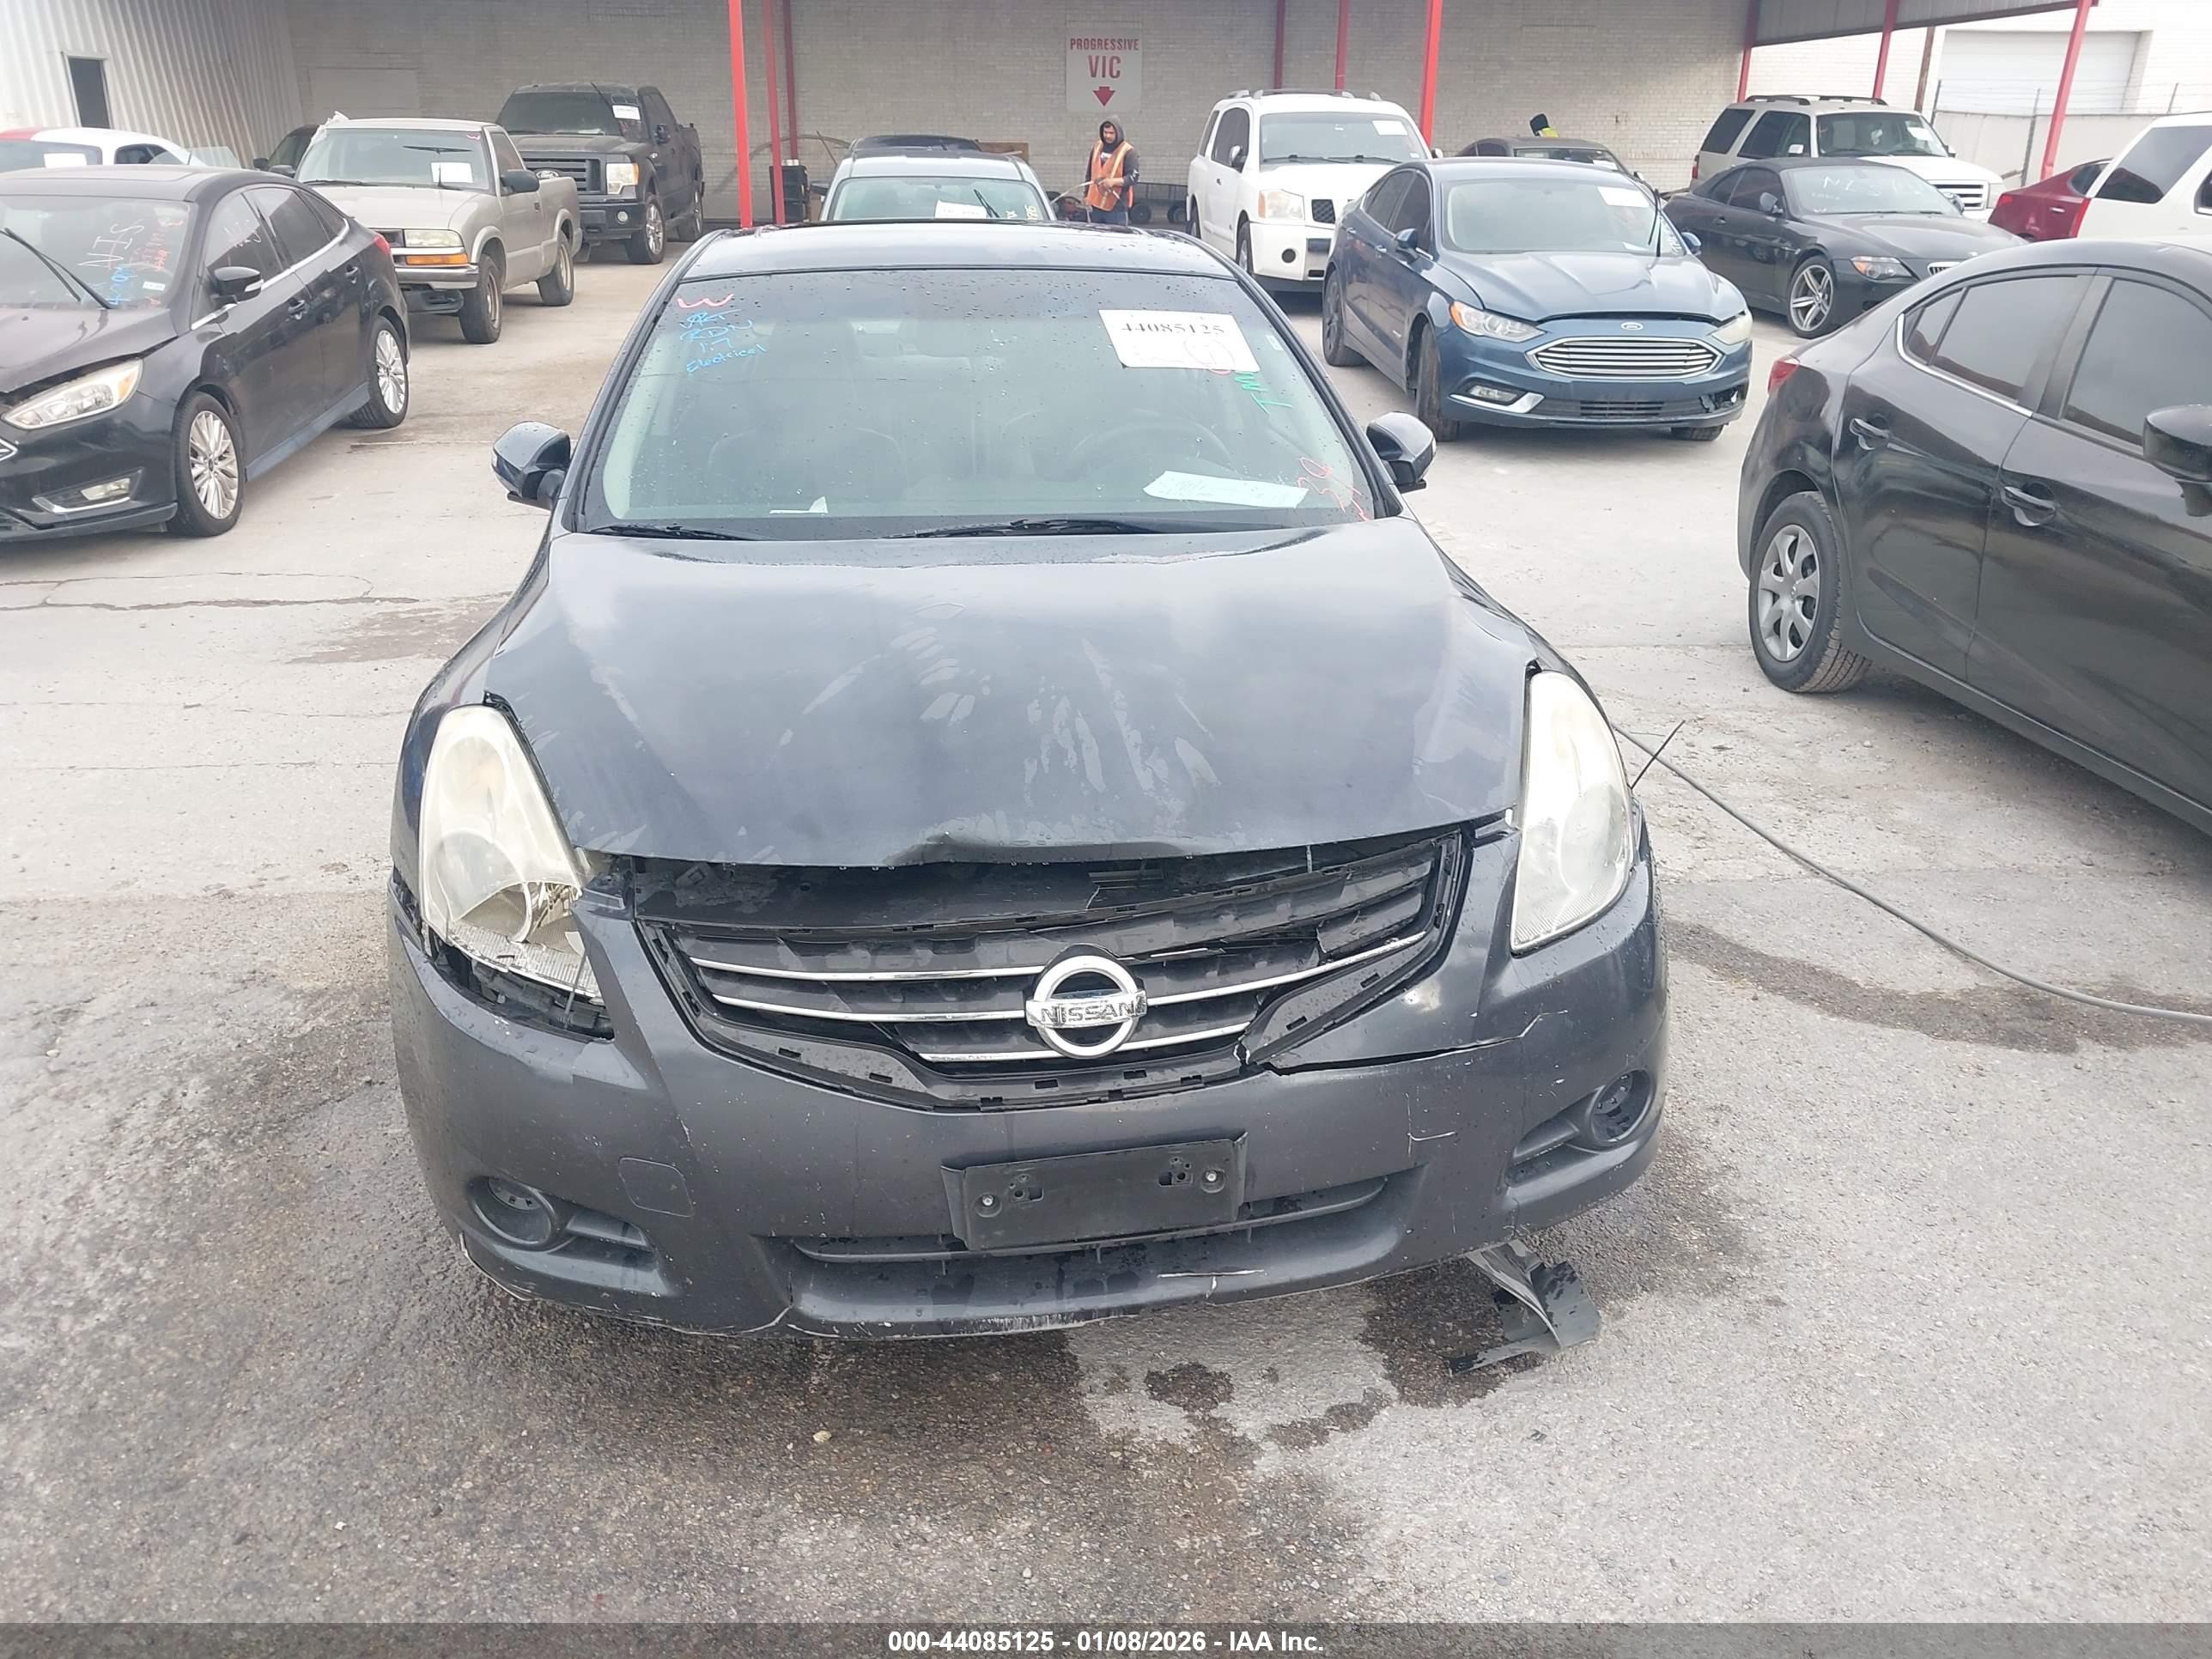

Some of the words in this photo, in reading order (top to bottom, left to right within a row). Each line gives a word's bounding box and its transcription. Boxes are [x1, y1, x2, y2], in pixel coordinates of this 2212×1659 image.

[1069, 37, 1140, 51] PROGRESSIVE
[1088, 54, 1121, 79] VIC
[1121, 322, 1226, 335] 44085125
[1040, 1000, 1135, 1026] NISSAN
